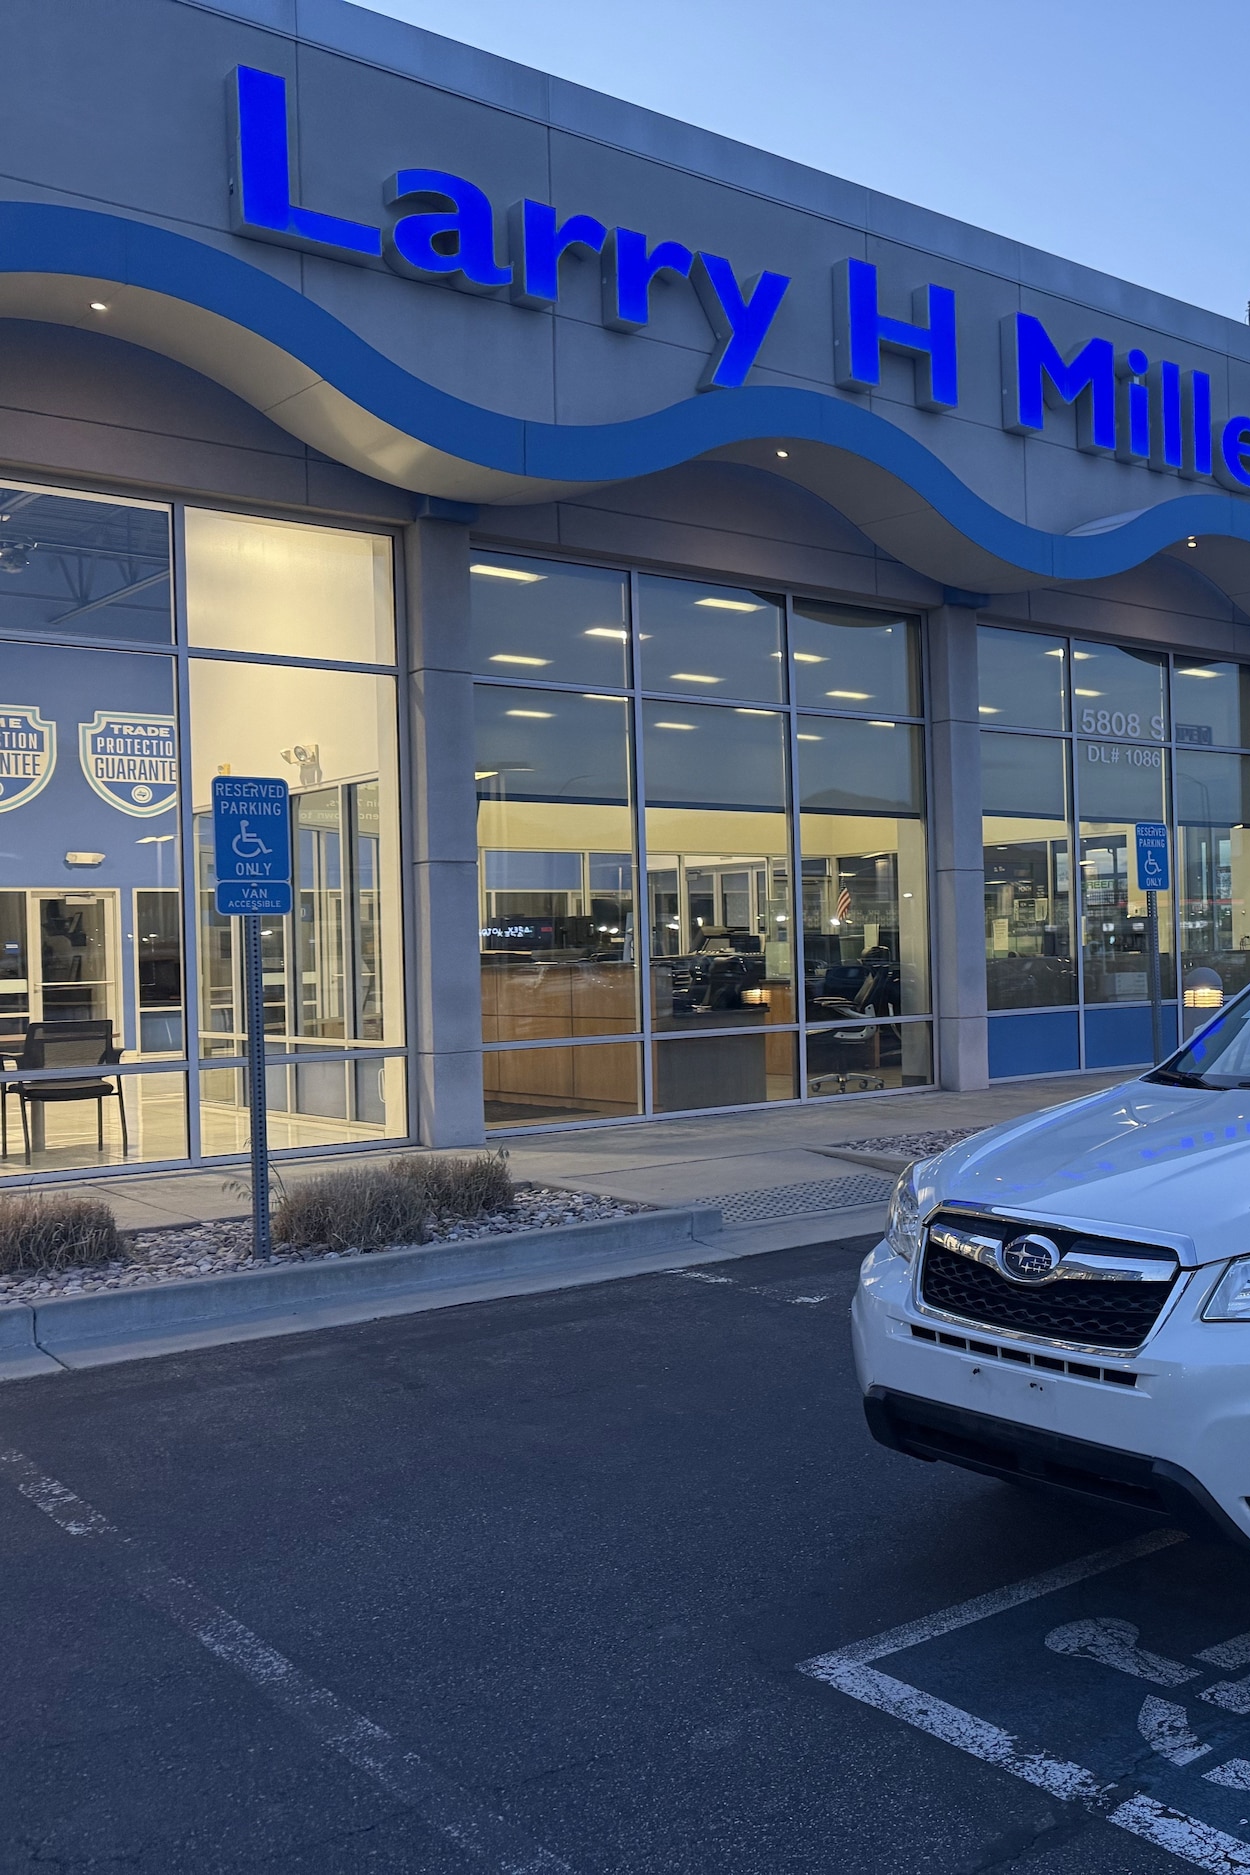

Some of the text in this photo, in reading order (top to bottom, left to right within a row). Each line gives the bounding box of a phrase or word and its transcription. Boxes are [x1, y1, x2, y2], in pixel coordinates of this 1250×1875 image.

[229, 63, 791, 390] Larry
[838, 257, 958, 411] H
[109, 724, 170, 738] TRADE
[1081, 708, 1140, 738] 5808
[1150, 714, 1165, 740] S
[0, 731, 37, 750] TION
[1087, 744, 1161, 768] DL# 1086
[215, 782, 284, 798] RESERVED
[220, 801, 281, 816] PARKING
[1136, 826, 1166, 837] RESERVED
[1138, 838, 1166, 848] PARKING
[235, 862, 272, 876] ONLY
[1146, 877, 1162, 887] ONLY
[242, 888, 267, 899] VAN
[228, 900, 281, 908] ACCESSIBLE
